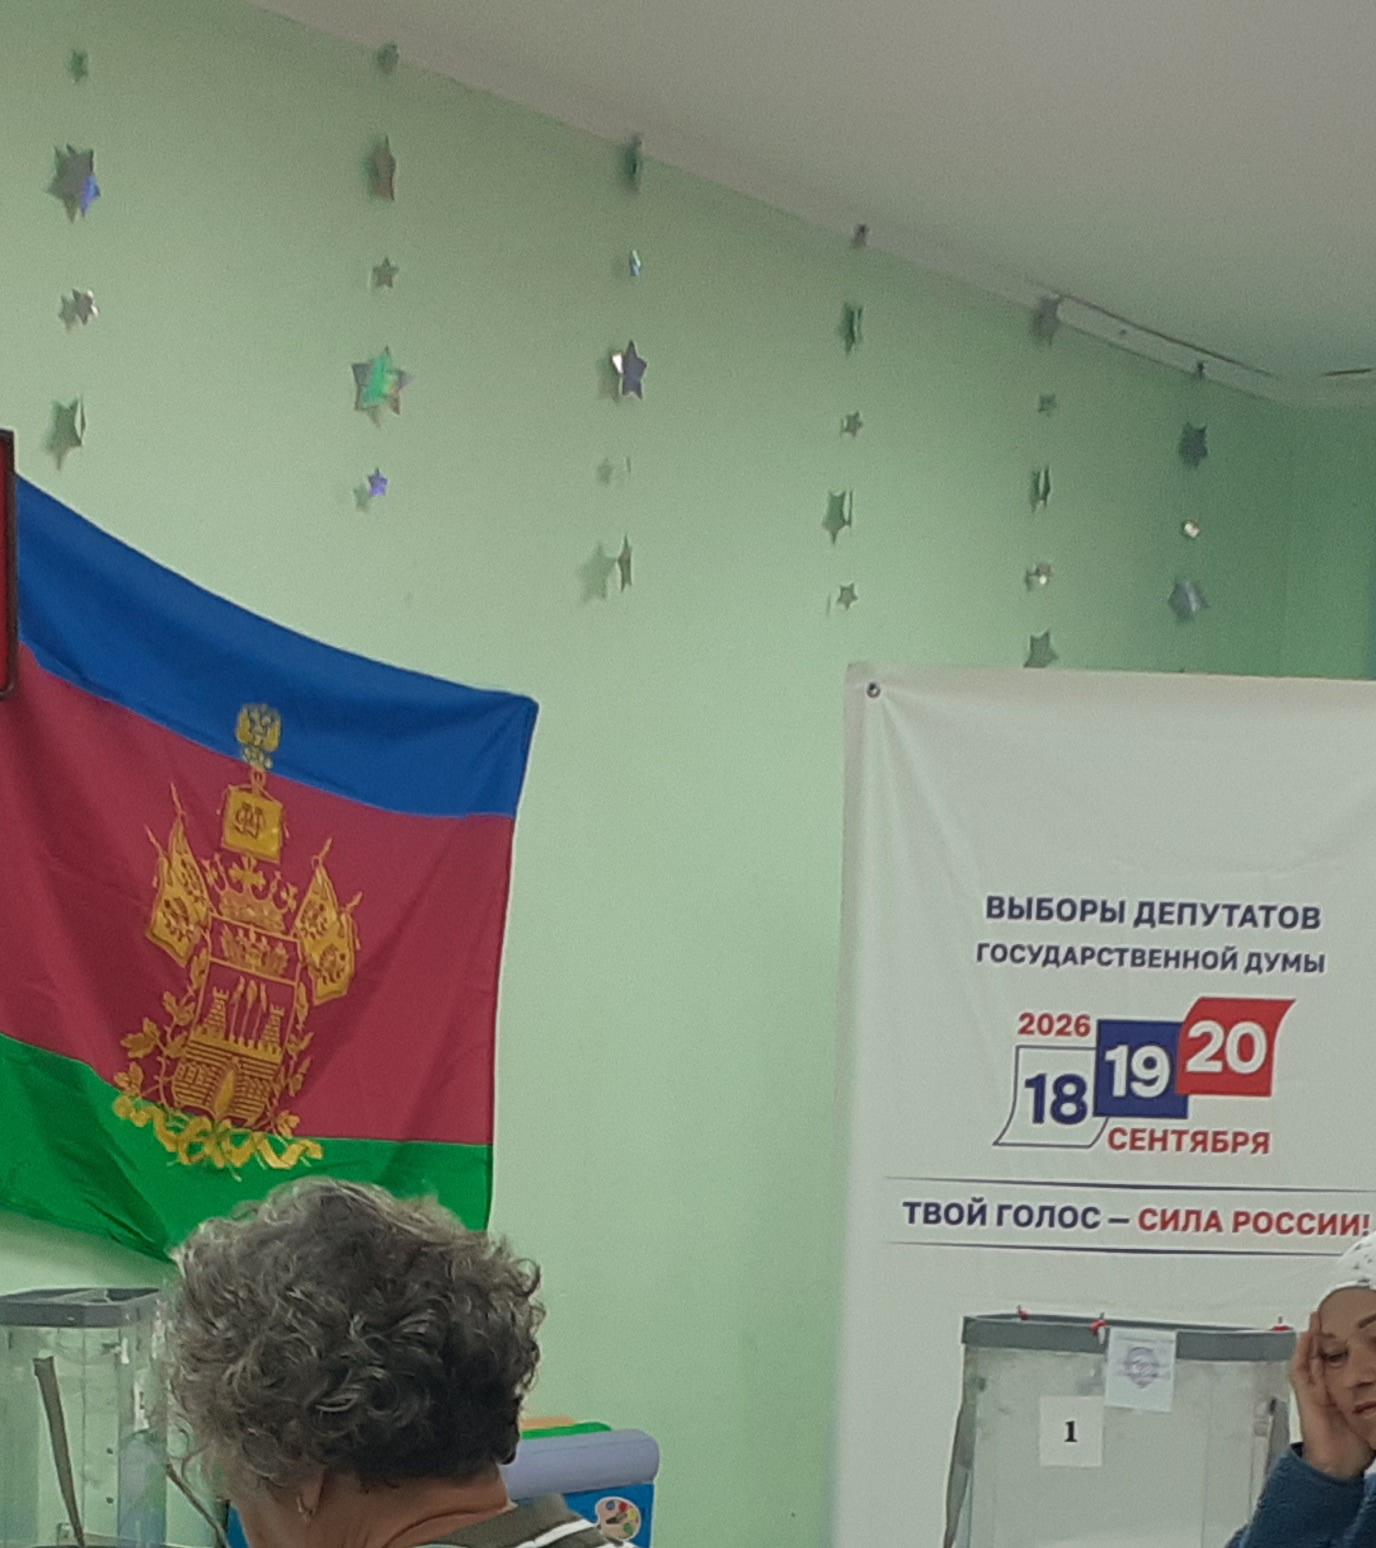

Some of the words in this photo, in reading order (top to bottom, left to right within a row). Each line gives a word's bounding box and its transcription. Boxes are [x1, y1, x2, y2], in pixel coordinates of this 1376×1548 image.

[986, 895, 1125, 924] ВЫБОРЫ
[1132, 901, 1321, 929] ДЕПУТАТОВ
[976, 943, 1238, 972] ГОСУДАРСТВЕННОЙ
[1243, 952, 1326, 975] ДУМЫ
[1017, 1012, 1091, 1037] 2026
[1024, 1073, 1088, 1125] 18
[1104, 1044, 1171, 1098] 19
[1185, 1020, 1268, 1074] 20
[1107, 1128, 1271, 1155] СЕНТЯБРЯ
[902, 1197, 988, 1227] ТВОЙ
[996, 1203, 1101, 1230] ГОЛОС
[1138, 1208, 1223, 1233] СИЛА
[1231, 1211, 1371, 1237] РОССИИ!
[1064, 1420, 1078, 1443] 1
